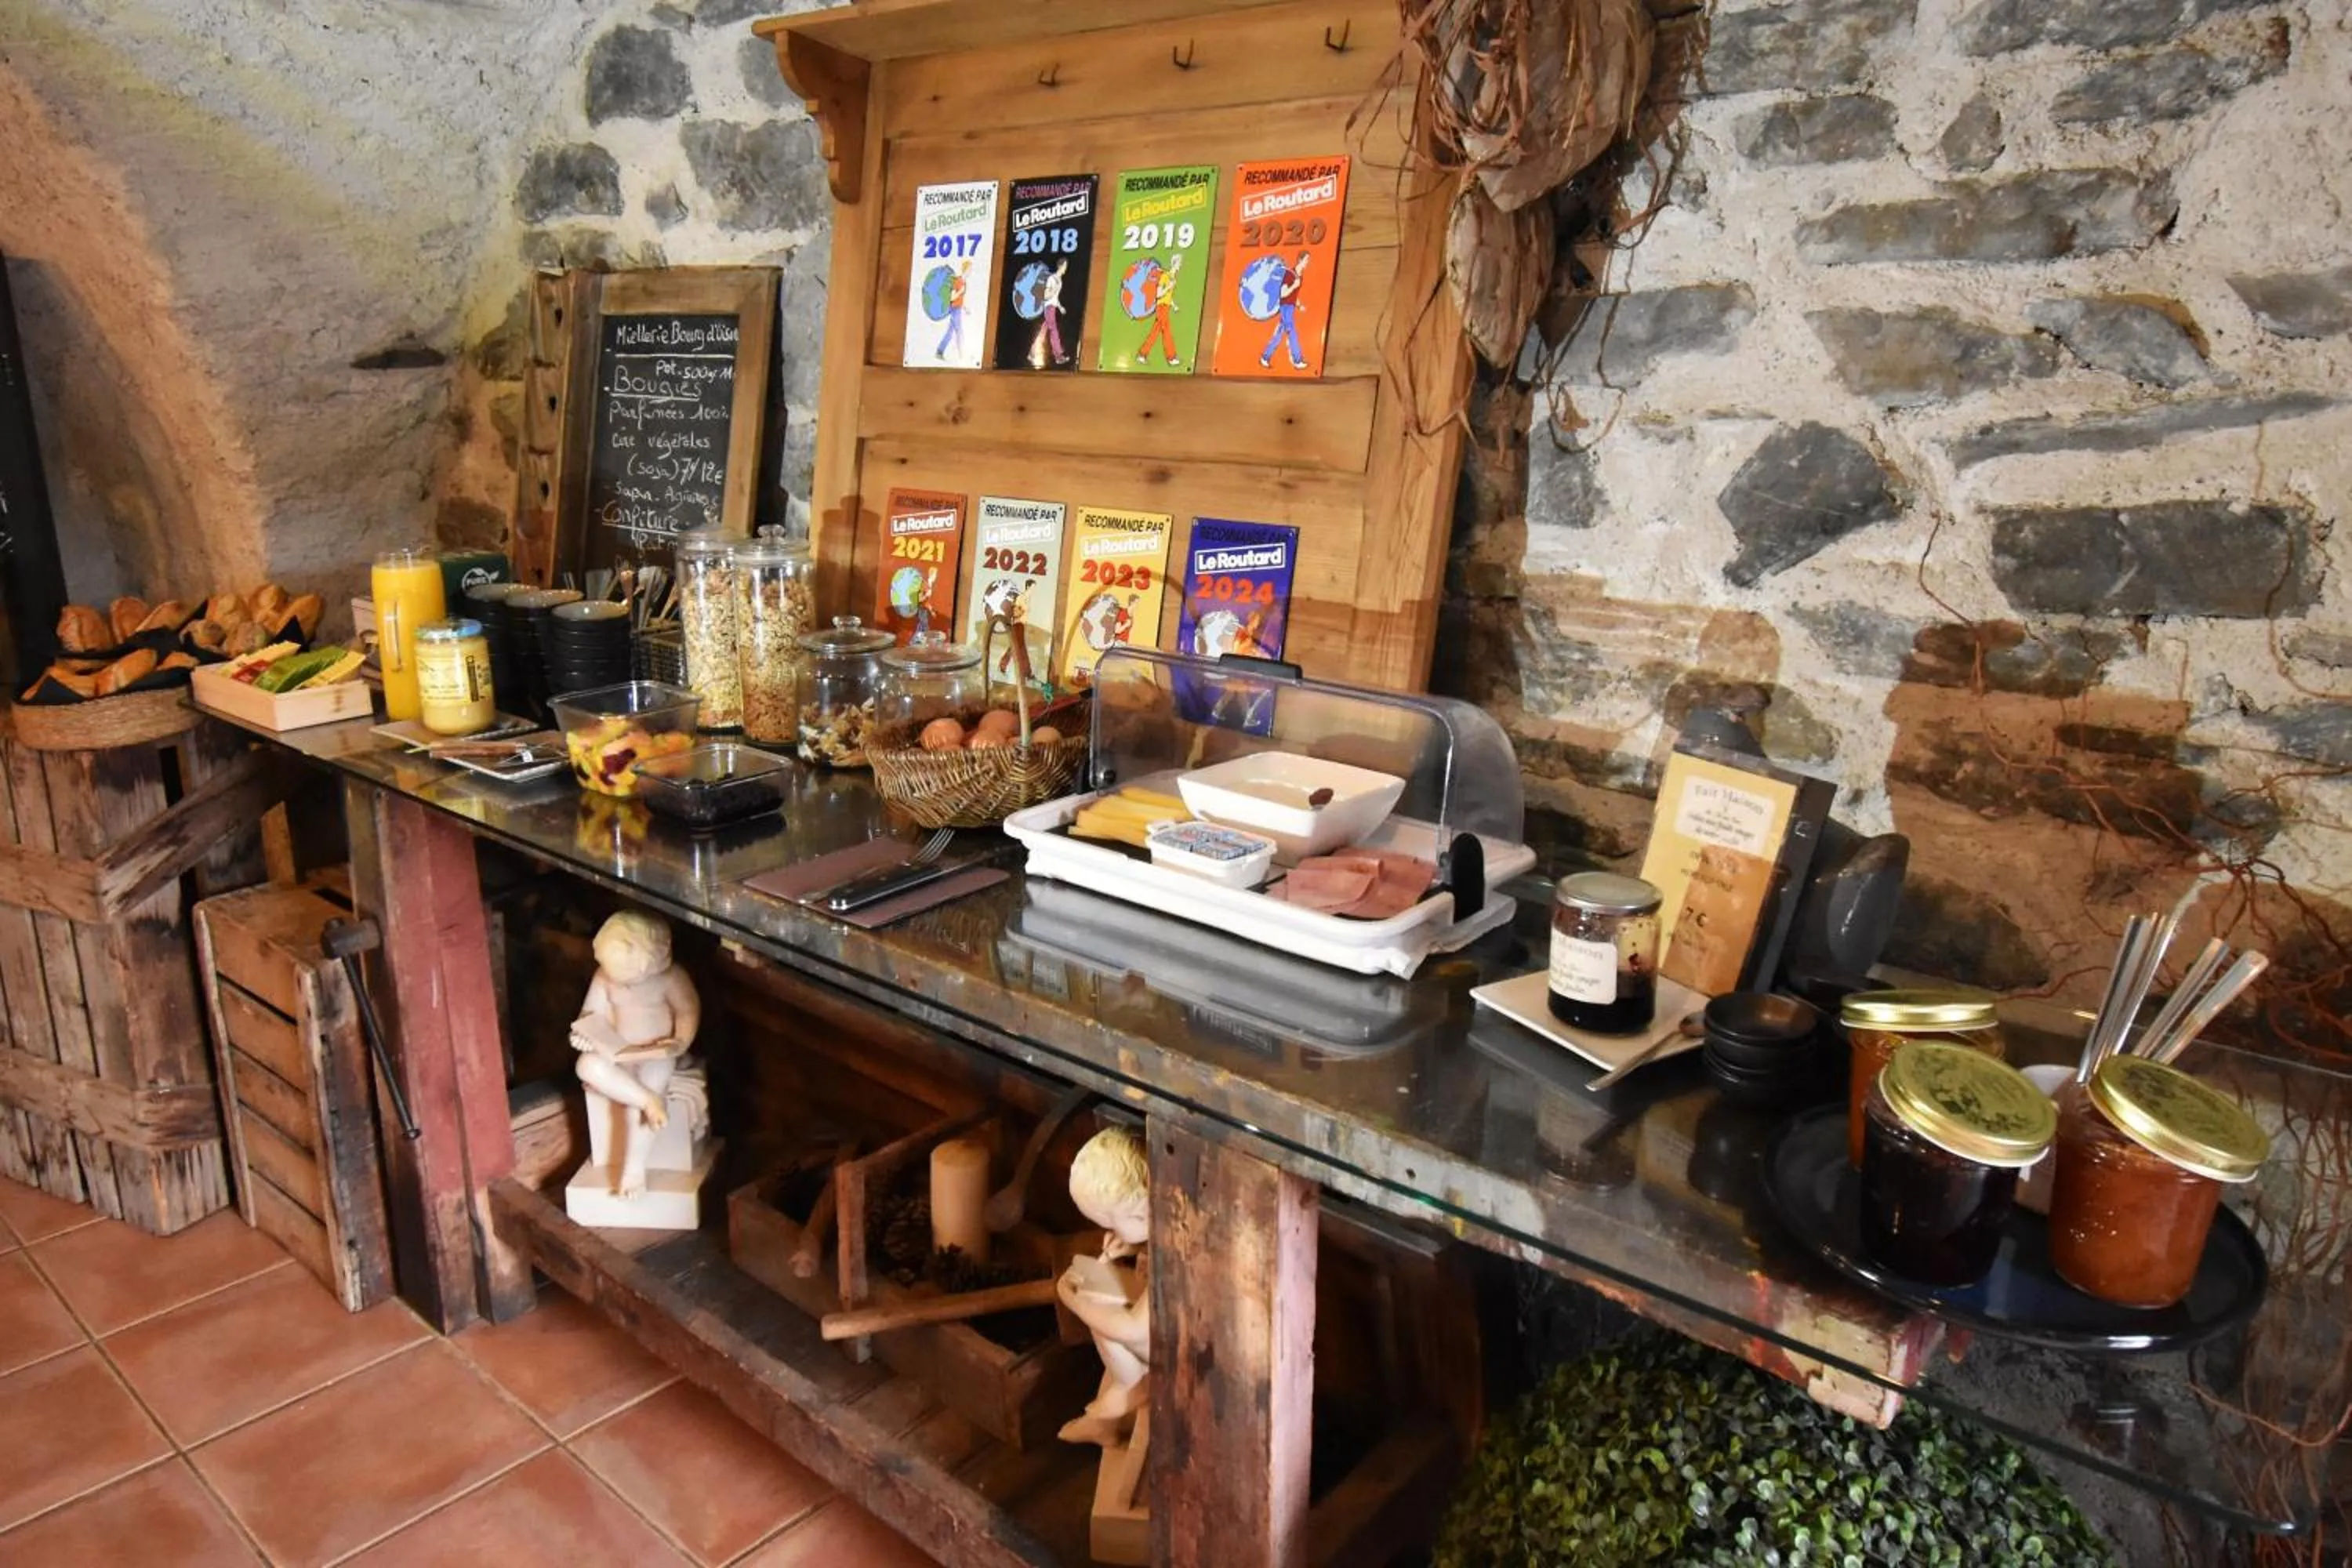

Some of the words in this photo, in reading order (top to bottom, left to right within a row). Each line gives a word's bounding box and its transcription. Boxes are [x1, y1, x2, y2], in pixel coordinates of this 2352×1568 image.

[1125, 172, 1189, 191] RECOMMANDÉ
[1189, 173, 1210, 185] PAR
[1245, 163, 1317, 184] RECOMMANDÉ
[1318, 164, 1341, 177] PAR
[924, 188, 975, 205] RECOMMANDÉ
[976, 189, 993, 201] PAR
[1125, 207, 1142, 223] Le
[1142, 188, 1204, 217] Routard
[1244, 200, 1263, 217] Le
[1263, 180, 1334, 212] Routard
[925, 218, 937, 232] Le
[938, 201, 987, 227] Routard
[1015, 213, 1030, 228] Le
[1031, 195, 1086, 223] Routard
[924, 234, 982, 258] 2017
[1014, 228, 1078, 255] 2018
[1122, 223, 1195, 251] 2019
[1240, 218, 1327, 248] 2020
[893, 520, 907, 532] Le
[908, 512, 954, 531] Routard
[985, 504, 1039, 521] RECOMMANDÉ
[1040, 509, 1058, 524] PAR
[1084, 514, 1145, 532] RECOMMANDÉ
[1145, 521, 1165, 535] PAR
[985, 528, 1000, 543] Le
[1000, 523, 1052, 542] Routard
[1083, 539, 1100, 557] Le
[1100, 535, 1159, 555] Routard
[891, 535, 946, 563] 2021
[982, 546, 1047, 576] 2022
[1199, 554, 1217, 570] Le
[1218, 547, 1282, 568] Routard
[1080, 559, 1151, 590] 2023
[1196, 575, 1274, 604] 2024
